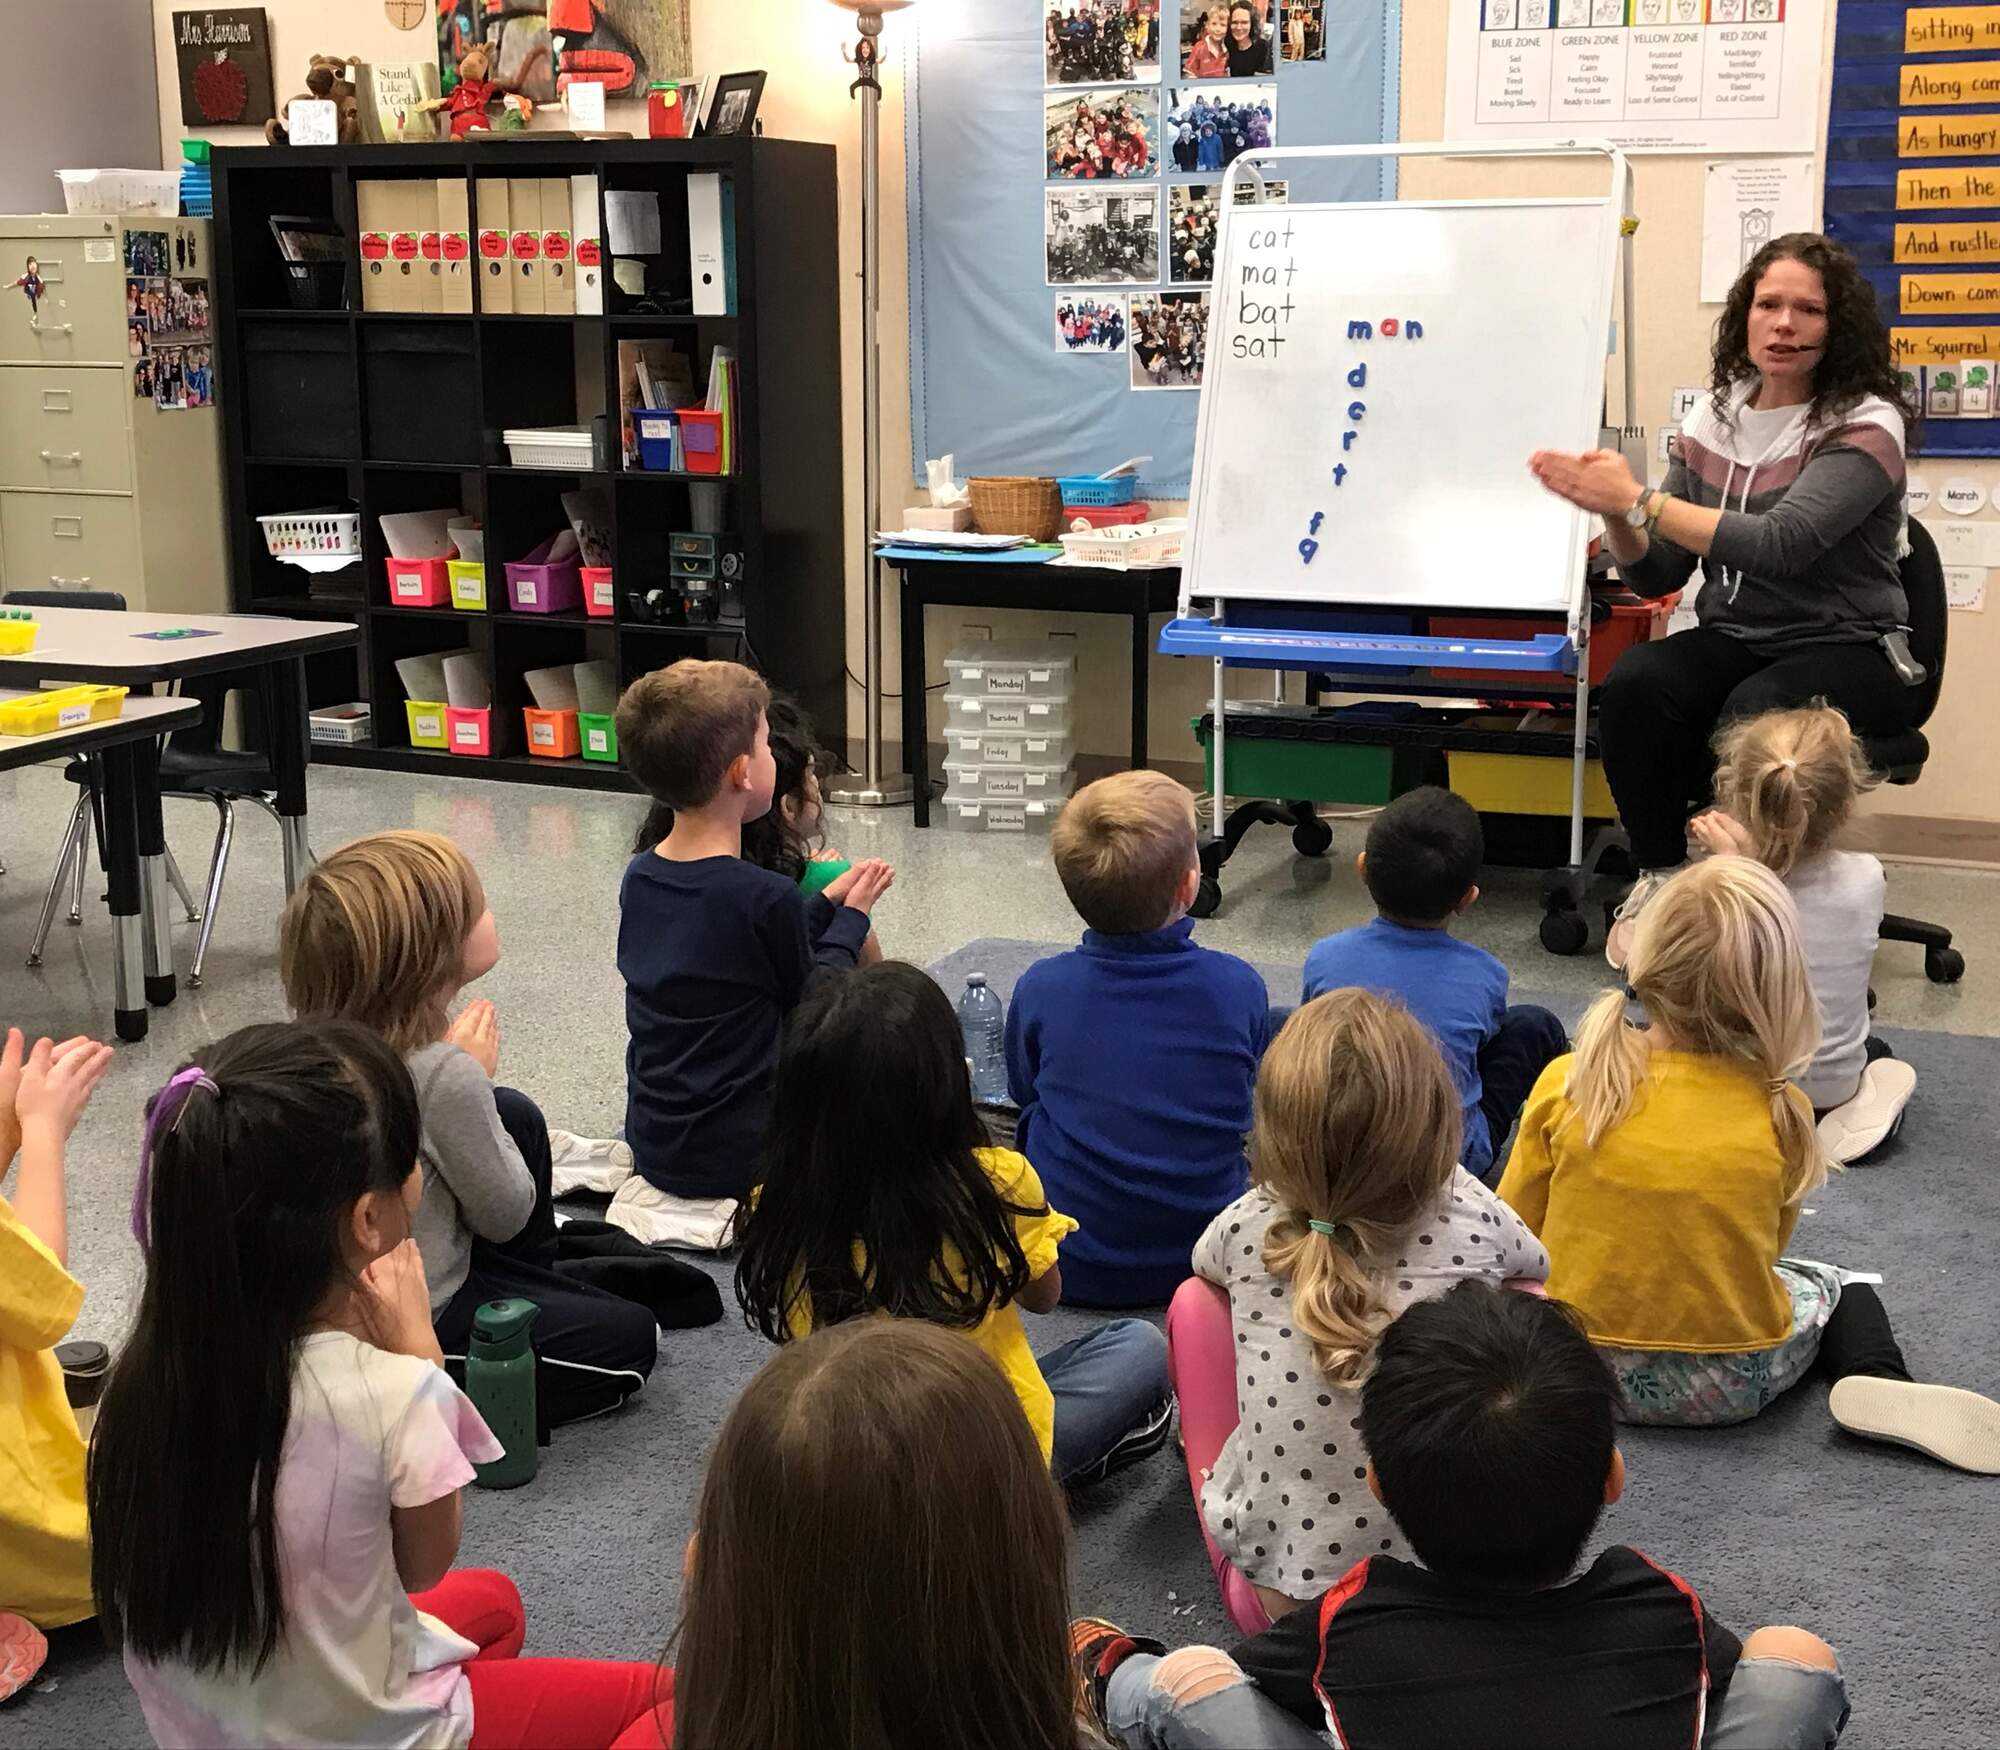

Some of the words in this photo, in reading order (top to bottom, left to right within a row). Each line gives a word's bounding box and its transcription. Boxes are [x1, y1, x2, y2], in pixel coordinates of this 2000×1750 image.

[1634, 34, 1670, 44] YELLOW
[1673, 33, 1699, 42] ZONE
[1720, 32, 1738, 41] RED
[1741, 31, 1768, 40] ZONE
[1911, 17, 1974, 43] sitting
[1492, 39, 1514, 48] BLUE
[1516, 38, 1541, 47] ZONE
[1562, 36, 1591, 46] GREEN
[1594, 35, 1619, 44] ZONE
[380, 67, 410, 80] Stand
[380, 81, 404, 92] Like
[1909, 75, 1961, 100] Along
[381, 95, 388, 105] A
[1906, 126, 1930, 150] As
[1939, 124, 1997, 150] hungry
[1906, 180, 1950, 202] Then
[1964, 174, 1996, 197] the
[1250, 218, 1295, 249] cat
[1904, 231, 1940, 256] And
[1950, 230, 2000, 252] rustle
[1242, 257, 1299, 286] mat
[1908, 281, 1956, 304] Down
[1239, 290, 1296, 324] bat
[1232, 327, 1286, 358] sat
[1896, 338, 1918, 354] Mr
[1926, 334, 1988, 360] Squirrel
[1348, 362, 1366, 388] d
[1682, 395, 1694, 412] H
[1938, 396, 1948, 408] 3
[1970, 394, 1978, 405] 4
[1343, 431, 1358, 450] r
[1332, 463, 1348, 486] t
[1947, 490, 1979, 500] March
[1310, 512, 1324, 536] f
[990, 679, 1024, 691] Monday
[989, 714, 1018, 723] Thursday
[986, 748, 1008, 758] Friday
[988, 782, 1019, 792] Tuesday
[989, 814, 1024, 824] Wednesday
